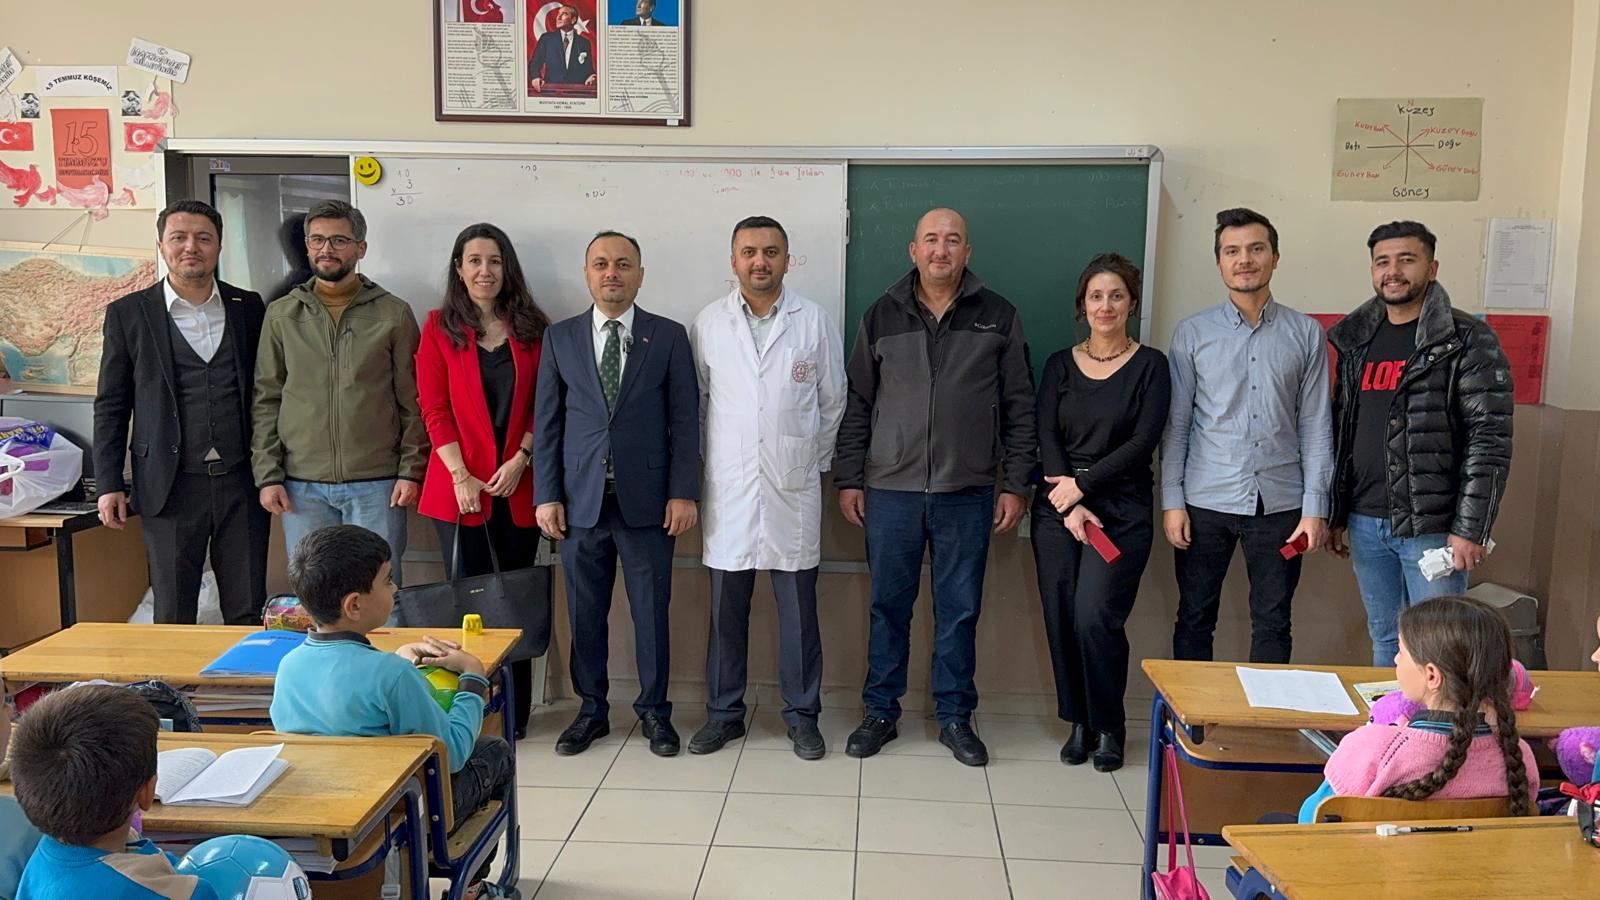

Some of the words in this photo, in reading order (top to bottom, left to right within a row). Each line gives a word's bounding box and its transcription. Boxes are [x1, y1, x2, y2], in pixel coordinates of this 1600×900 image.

[46, 82, 54, 91] 15
[53, 74, 82, 85] TEMMUZ
[62, 120, 99, 158] 15
